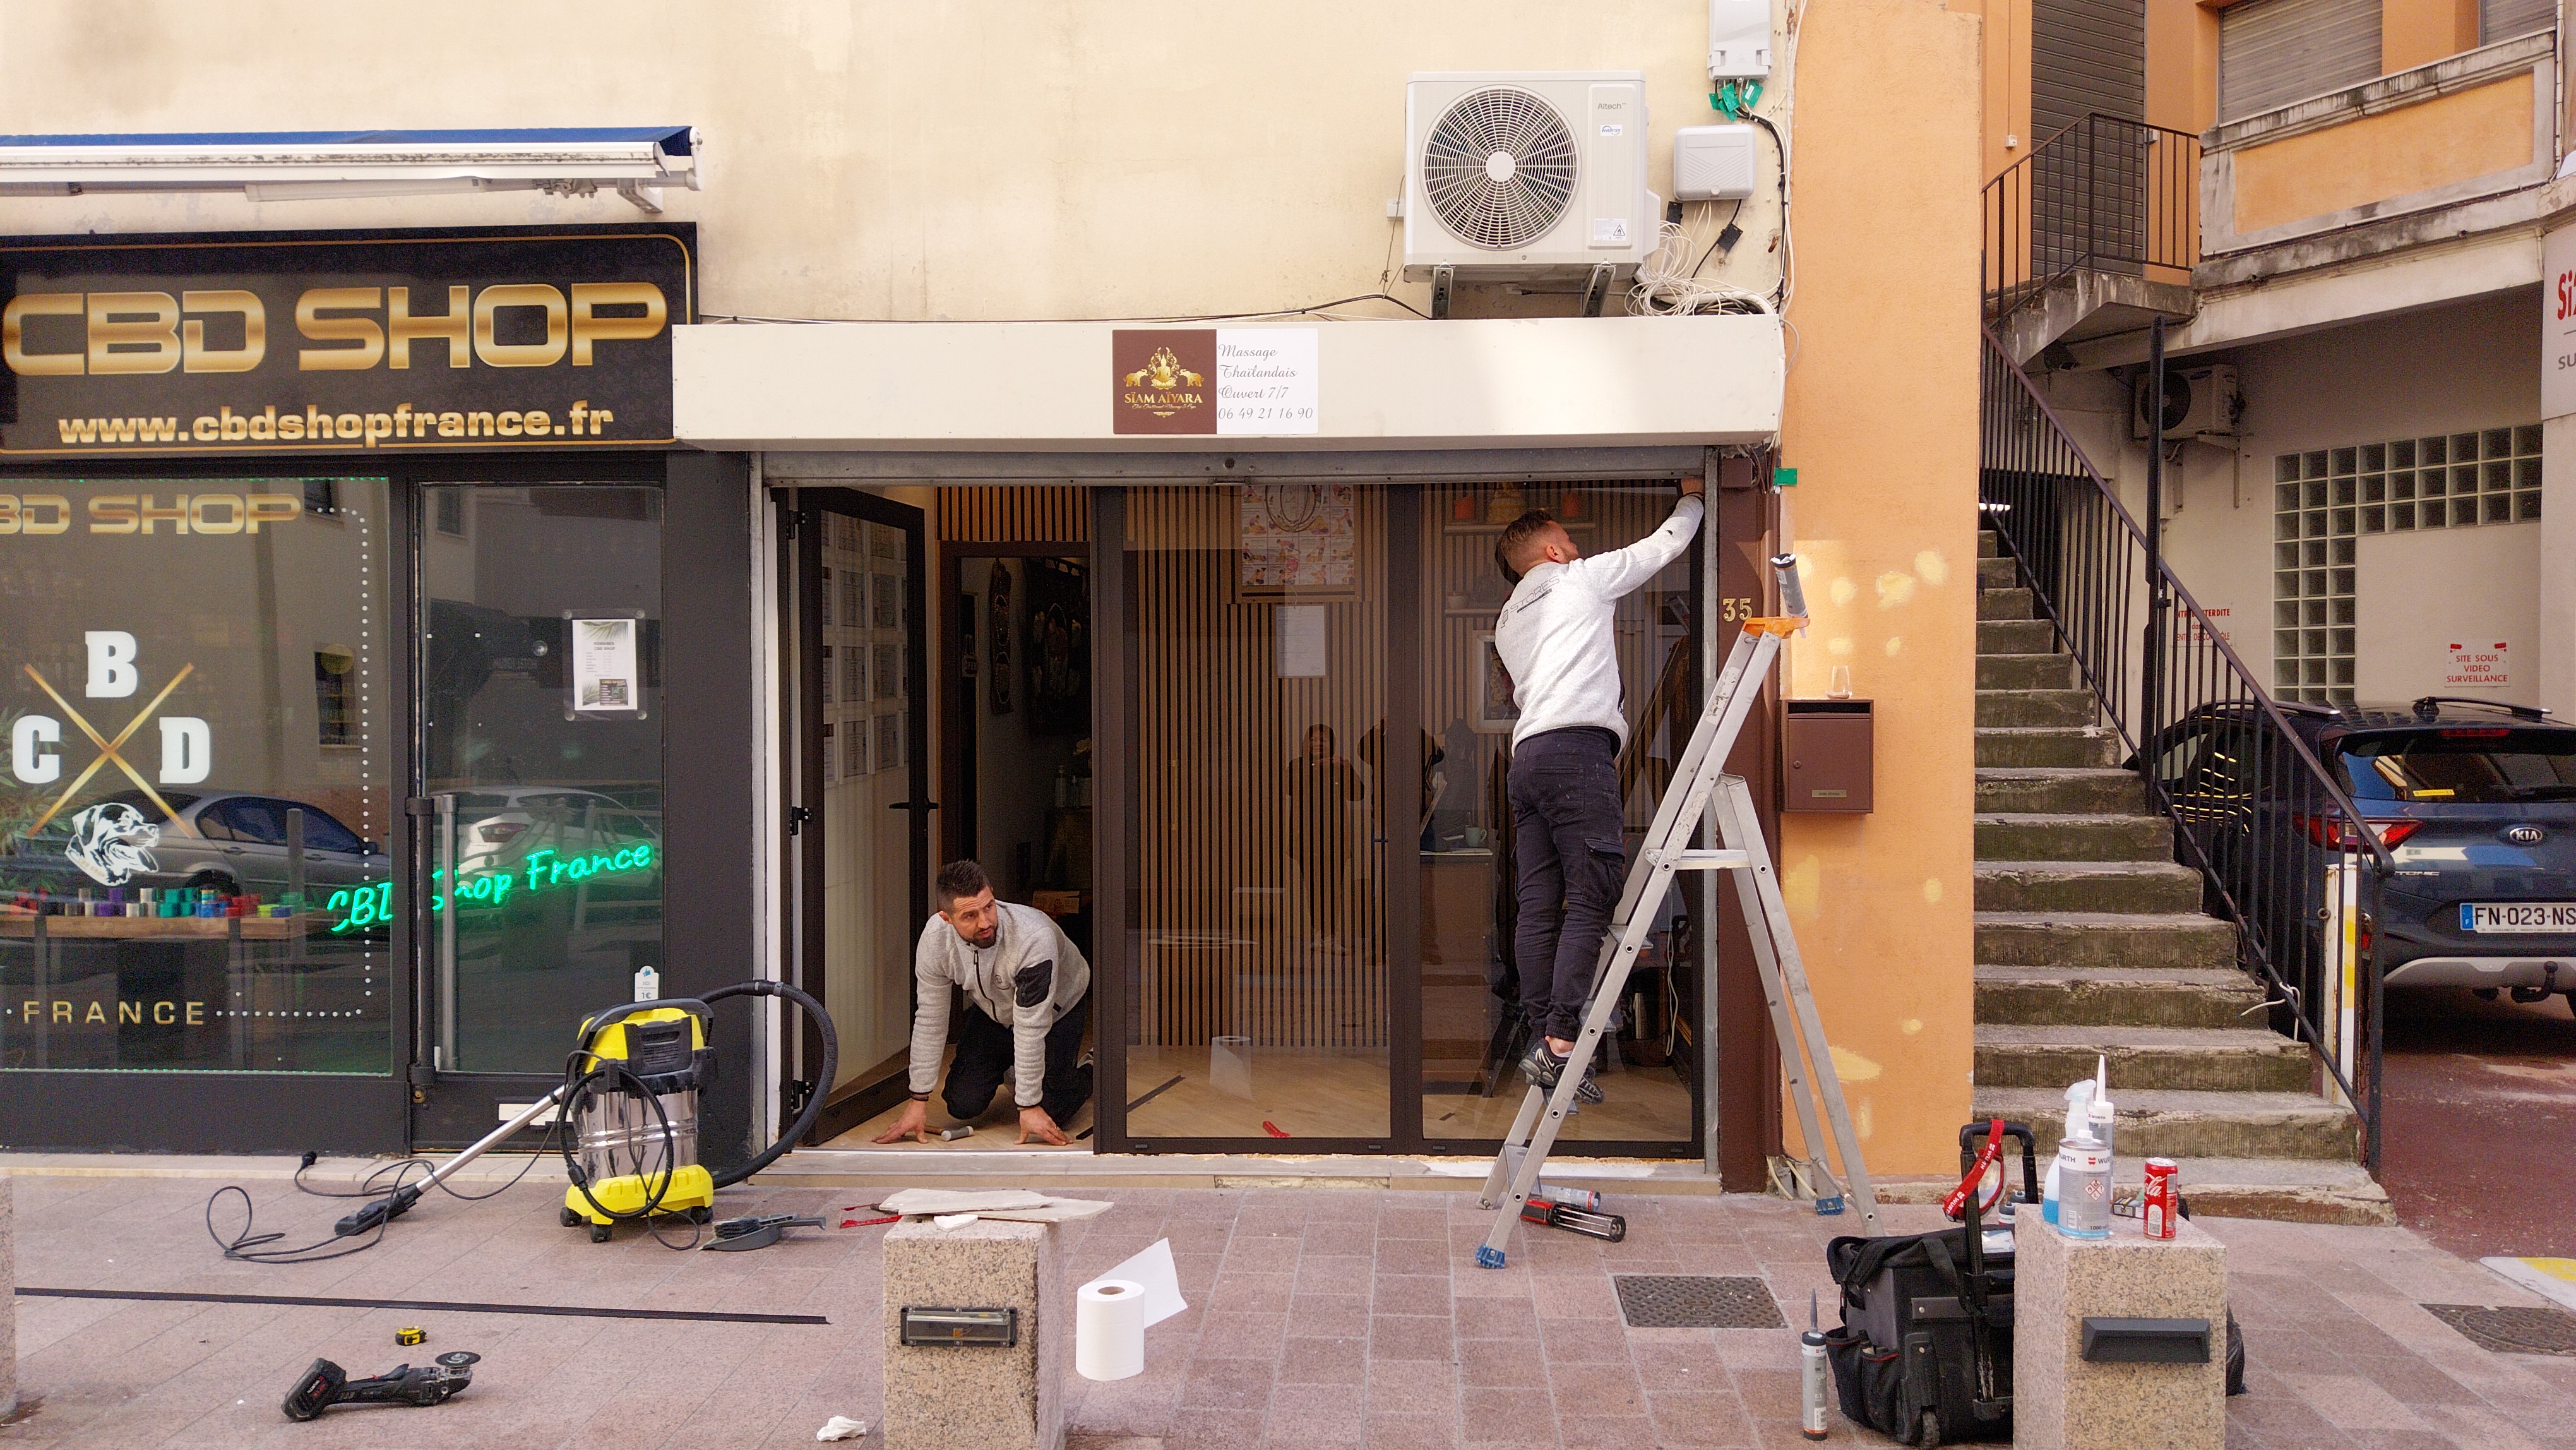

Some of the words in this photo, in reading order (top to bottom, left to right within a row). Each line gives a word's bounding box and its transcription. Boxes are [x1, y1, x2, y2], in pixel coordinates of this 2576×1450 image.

[2557, 270, 2576, 320] Si
[2, 290, 266, 376] CBD
[295, 282, 668, 371] SHOP
[1219, 344, 1278, 361] Massage
[1219, 364, 1298, 378] Thaïlandais
[1219, 385, 1265, 398] Ouvert
[1268, 385, 1289, 400] 7/7
[1218, 407, 1234, 419] 06
[1238, 407, 1253, 419] 49
[1258, 407, 1272, 419] 21
[1279, 407, 1292, 419] 16
[1297, 407, 1313, 419] 90
[59, 400, 614, 448] www.cbdshopfrance.fr
[88, 493, 301, 534] SHOP
[1510, 575, 1560, 613] STORES
[1722, 597, 1753, 622] 35
[2456, 654, 2471, 662] SITE
[2475, 654, 2498, 662] SOUS
[2464, 664, 2491, 673] VIDEO
[2447, 674, 2508, 683] SURVEILLANCE
[2515, 830, 2538, 841] KIA
[526, 845, 650, 890] France
[2474, 907, 2576, 926] FN-023-NS
[23, 1000, 204, 1025] FRANCE
